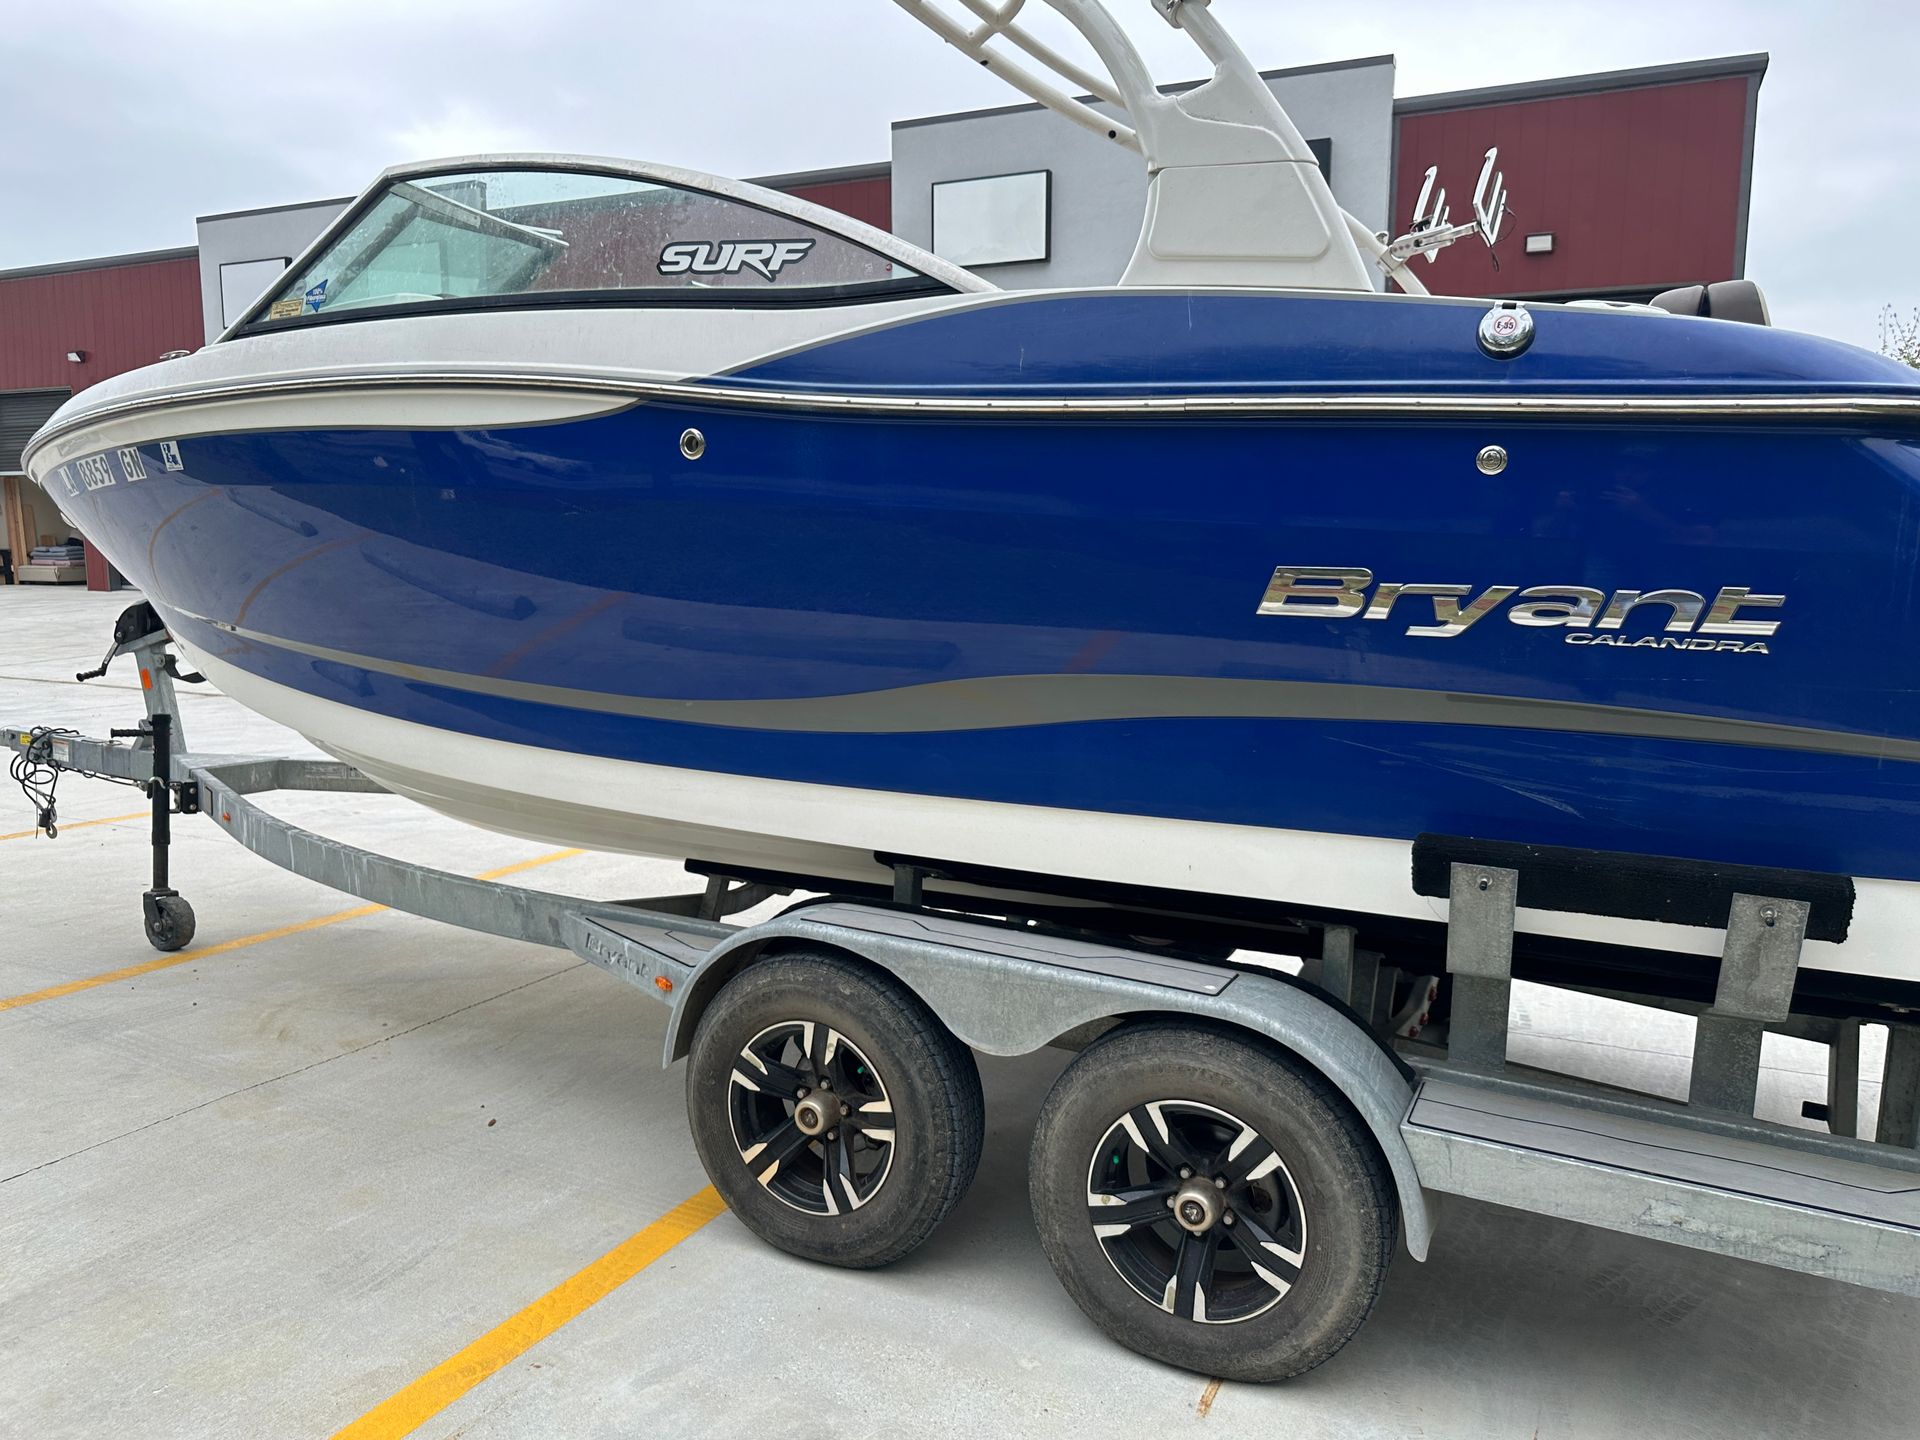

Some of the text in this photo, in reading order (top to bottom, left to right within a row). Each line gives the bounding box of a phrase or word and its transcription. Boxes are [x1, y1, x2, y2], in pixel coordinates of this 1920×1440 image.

[657, 239, 816, 282] SURF
[78, 456, 113, 488] 8859
[120, 448, 145, 479] GN
[1256, 565, 1786, 638] Bryant
[1564, 632, 1769, 655] CALANDRA
